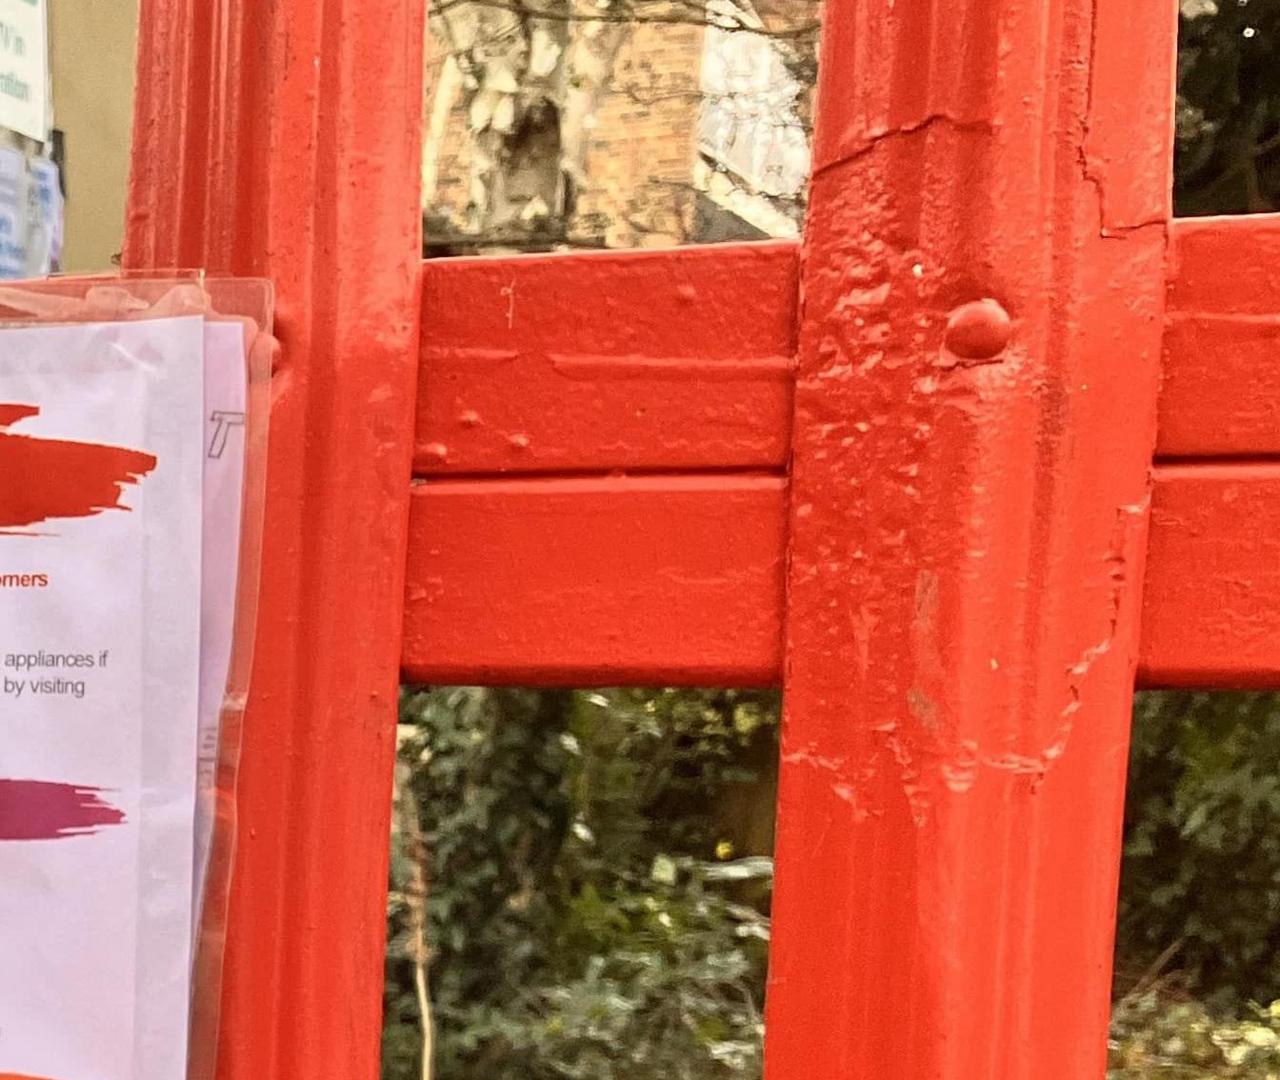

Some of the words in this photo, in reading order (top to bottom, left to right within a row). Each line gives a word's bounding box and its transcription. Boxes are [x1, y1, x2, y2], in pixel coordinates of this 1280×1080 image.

[4, 650, 94, 671] appliances
[98, 650, 108, 667] if
[4, 677, 25, 697] by
[30, 678, 85, 698] visiting
